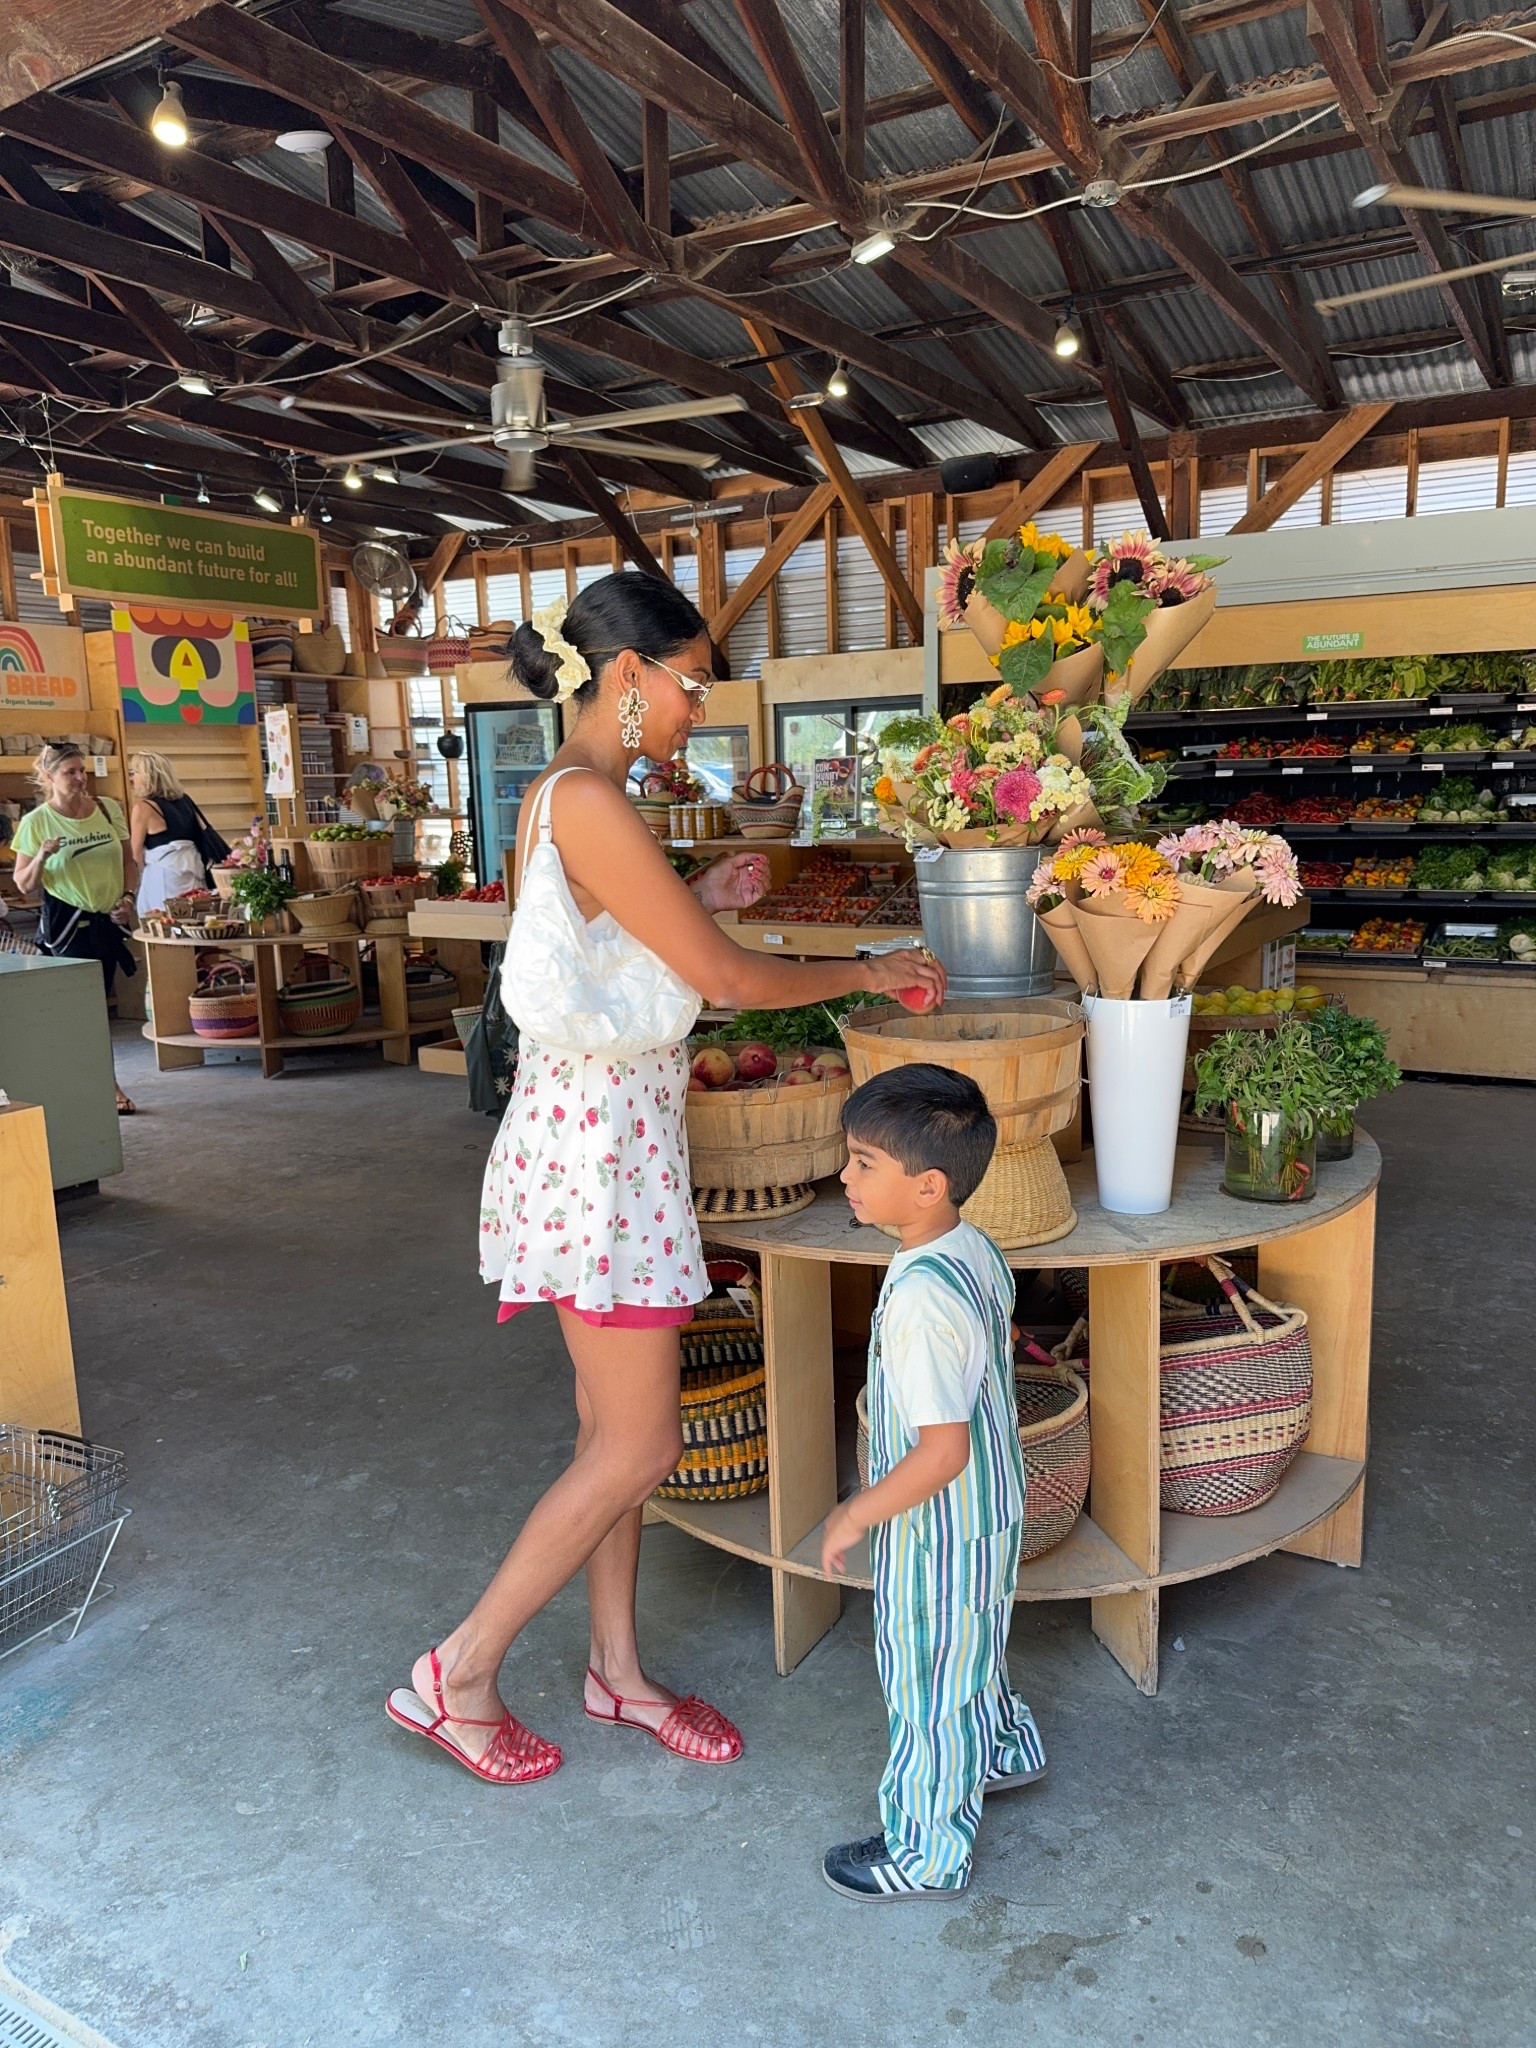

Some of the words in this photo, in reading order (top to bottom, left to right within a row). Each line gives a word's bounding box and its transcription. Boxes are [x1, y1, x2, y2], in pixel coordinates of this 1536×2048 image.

[82, 519, 162, 547] Together
[166, 536, 190, 551] we
[195, 540, 223, 556] can
[227, 541, 265, 561] build
[86, 549, 108, 564] an
[113, 549, 193, 575] abundant
[198, 560, 245, 581] future
[249, 567, 271, 584] for
[274, 571, 298, 588] all!
[1306, 639, 1359, 648] ABUNDANT
[6, 674, 77, 698] BREAD
[816, 763, 833, 772] COM-
[815, 771, 838, 780] MUNITY
[59, 832, 112, 847] Sunshine
